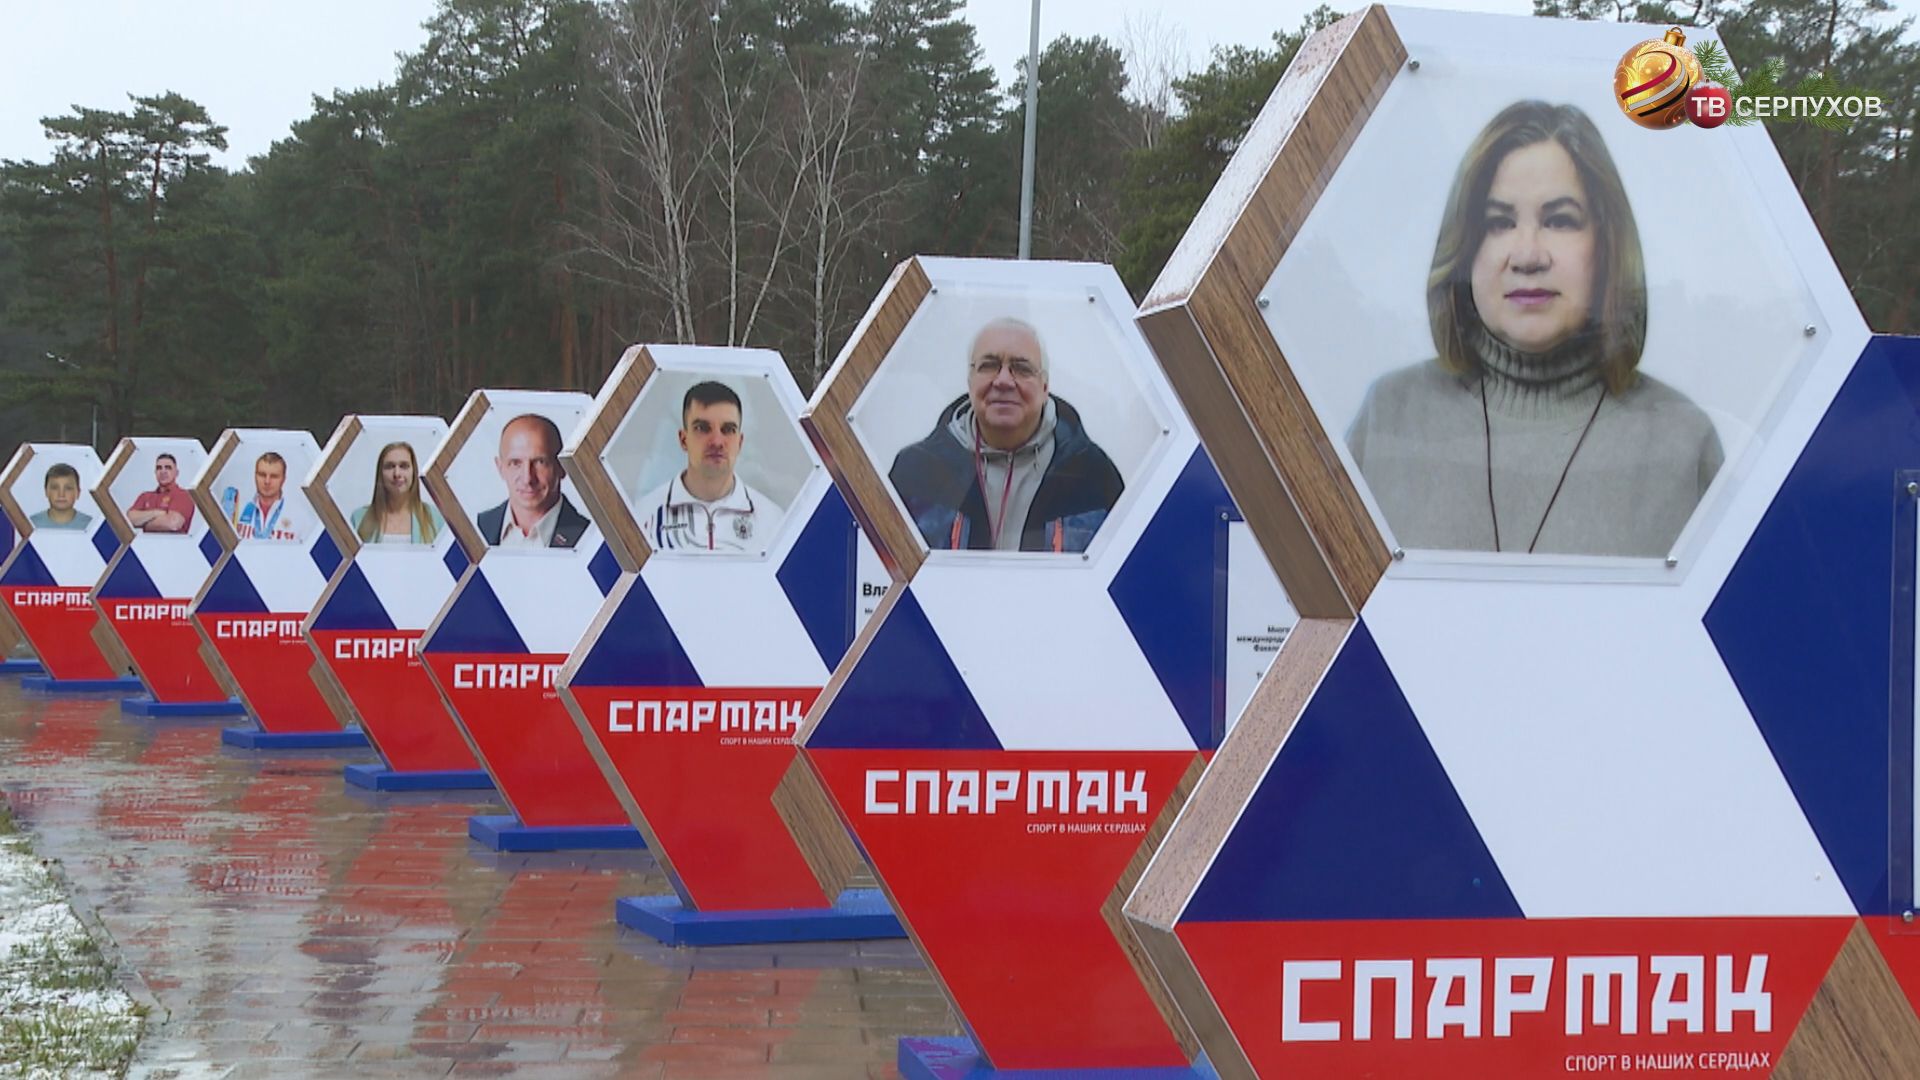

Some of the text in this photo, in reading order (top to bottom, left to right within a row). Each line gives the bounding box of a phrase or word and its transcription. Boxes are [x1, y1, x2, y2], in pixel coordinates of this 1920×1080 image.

[14, 592, 92, 606] СПАРТА
[115, 605, 188, 620] СПАРТ
[217, 620, 304, 638] СПАРТ
[335, 638, 420, 659] СПАР
[454, 664, 563, 689] СПАРТ
[609, 700, 803, 732] СПАРТАК
[865, 770, 1147, 814] СПАРТАК
[1027, 823, 1146, 834] СПОРТ В НАШИХ СЕРДЦАХ
[1282, 954, 1772, 1042] СПАРТАК
[1565, 1052, 1771, 1072] СПОРТ В НАШИХ СЕРДЦАХ
